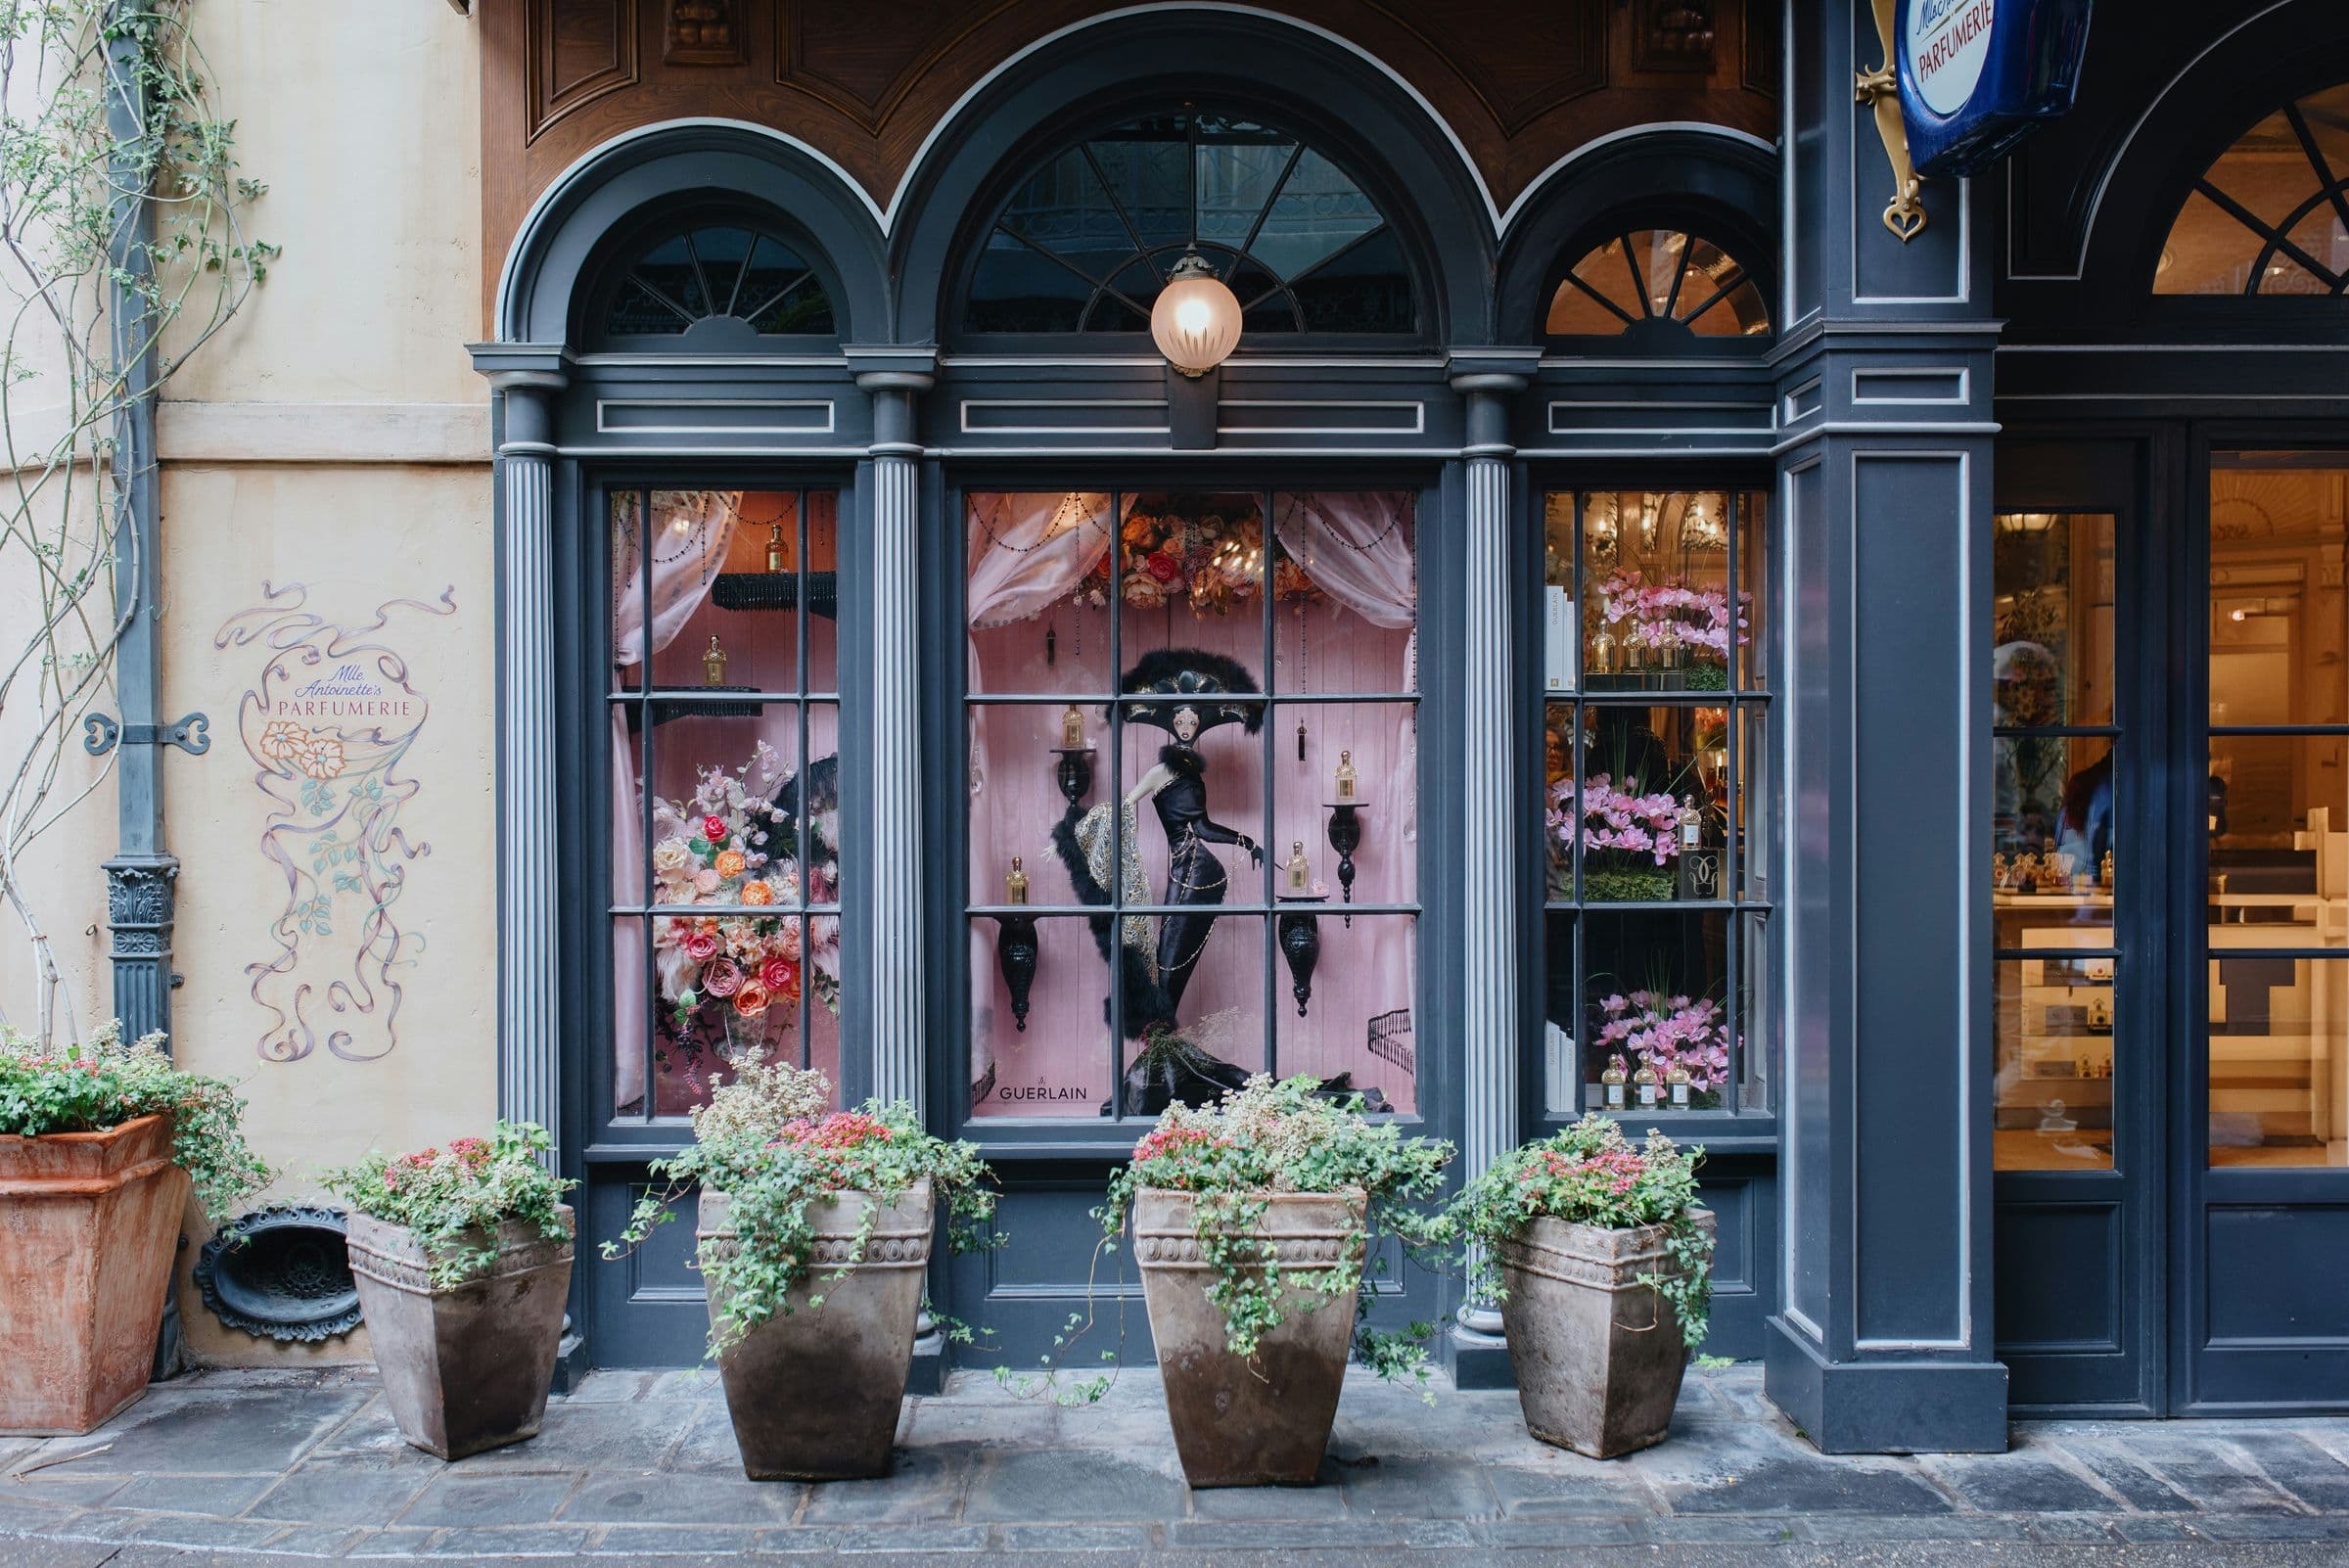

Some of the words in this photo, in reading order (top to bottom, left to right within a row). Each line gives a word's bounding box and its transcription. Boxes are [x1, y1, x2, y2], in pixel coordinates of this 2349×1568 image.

[1919, 0, 1993, 83] PARFUMERIE
[327, 665, 364, 682] Mlle
[295, 679, 382, 698] Antoinette's
[279, 701, 410, 716] PARFUMERIE
[999, 1086, 1086, 1100] GUERLAIN
